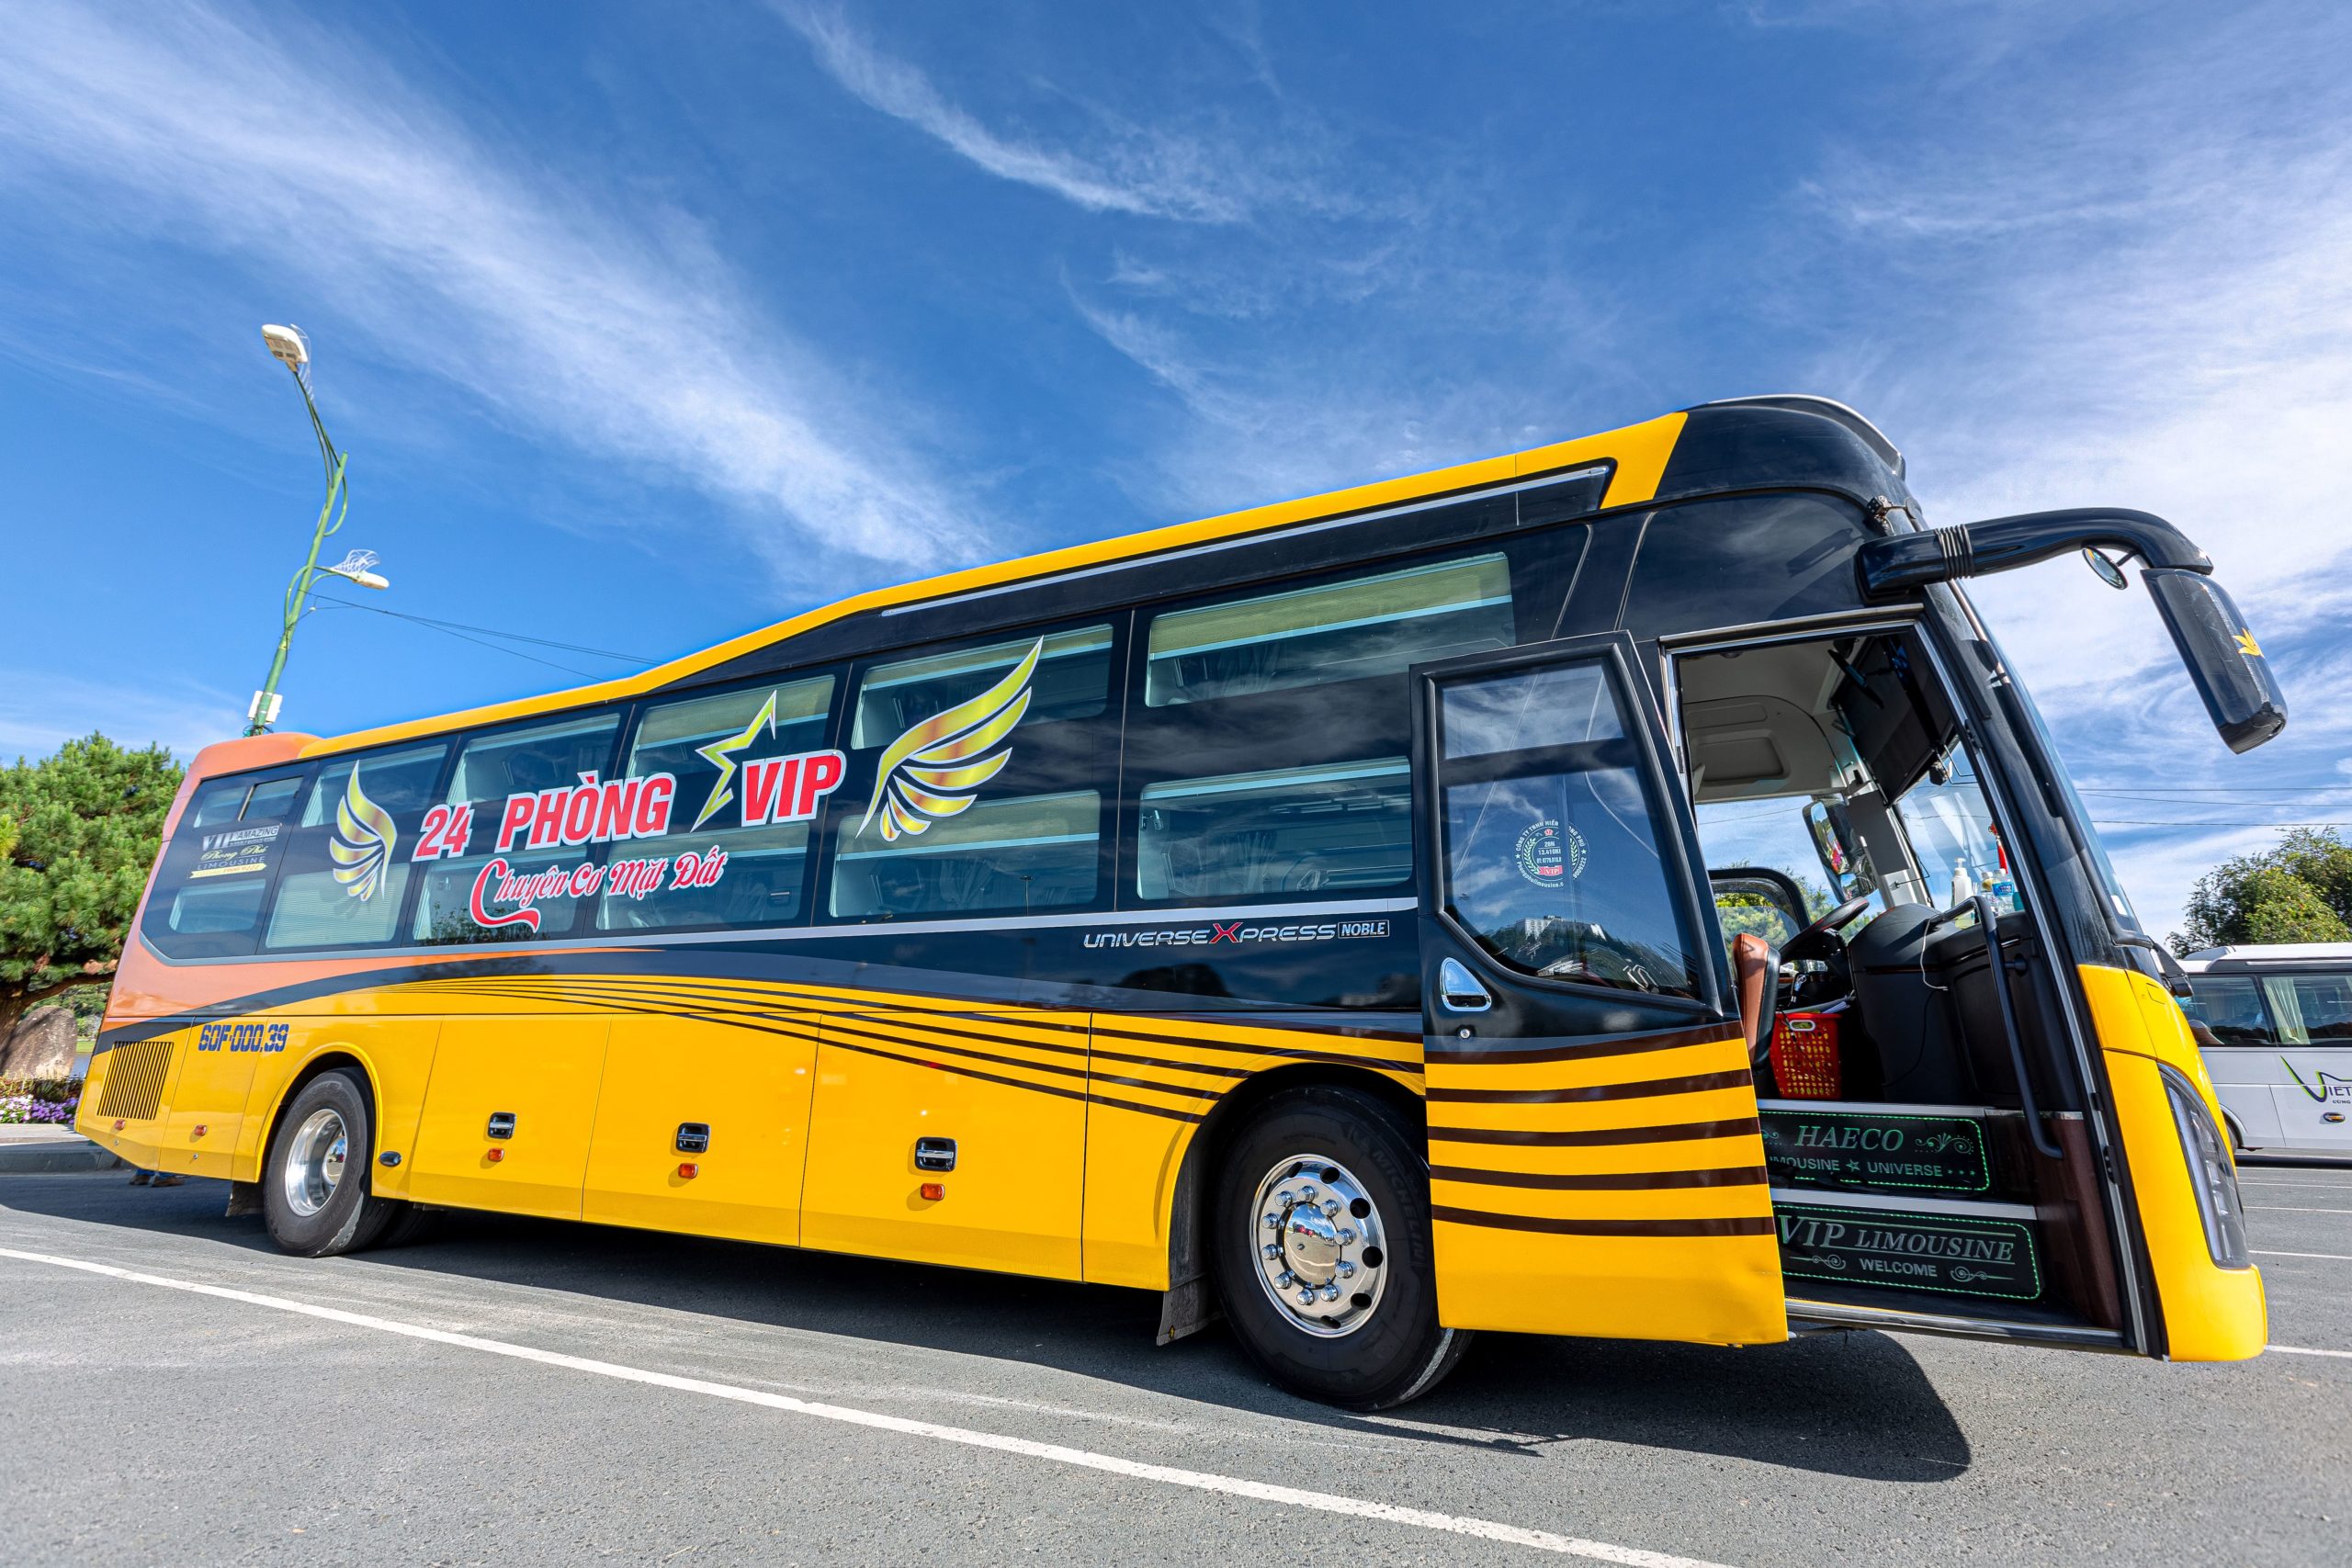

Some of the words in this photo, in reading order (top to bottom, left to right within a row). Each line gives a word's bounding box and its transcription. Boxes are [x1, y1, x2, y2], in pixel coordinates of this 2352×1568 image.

[413, 801, 471, 862] 24
[494, 770, 677, 853] PHÒNG
[741, 750, 846, 827] VIP
[238, 827, 277, 840] AMAZING
[197, 855, 266, 870] LIMOUSINE
[469, 857, 575, 933] Chuyên
[570, 866, 604, 897] Cơ
[608, 858, 670, 901] Mặt
[672, 844, 729, 888] Đất
[1340, 921, 1386, 938] NOBLE
[1794, 1125, 1905, 1151] HAECO
[1868, 1161, 1943, 1177] UNIVERSE
[1778, 1214, 1846, 1247] VIP
[1854, 1229, 2015, 1261] LIMOUSINE
[1860, 1258, 1938, 1278] WELCOME
